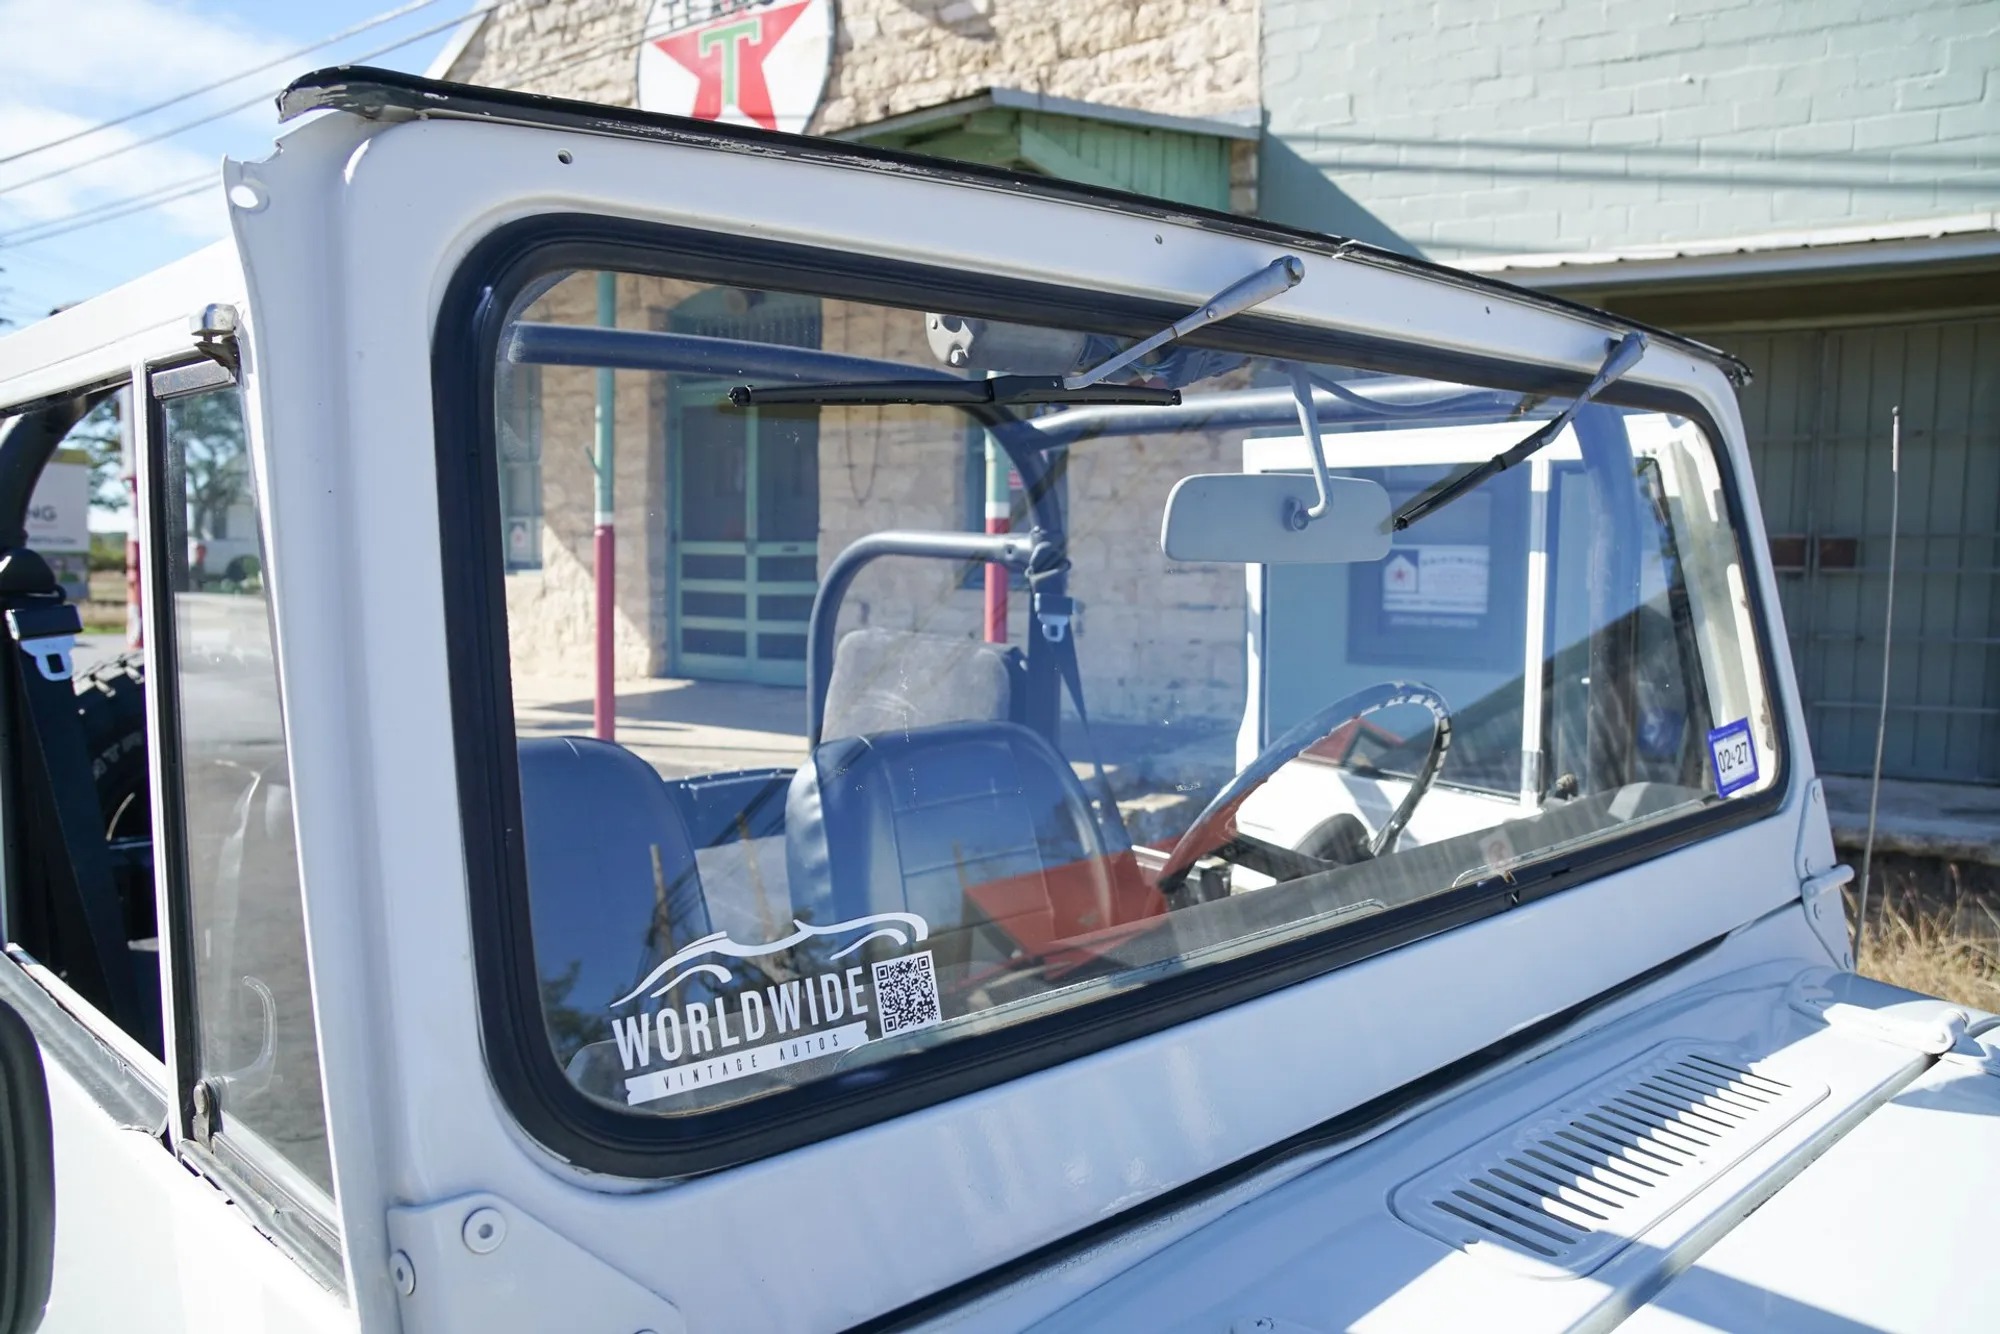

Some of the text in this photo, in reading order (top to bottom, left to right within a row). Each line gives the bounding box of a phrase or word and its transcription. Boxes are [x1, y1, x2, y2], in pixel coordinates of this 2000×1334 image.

[611, 966, 869, 1071] WORLDWIDE
[663, 1033, 839, 1090] VINTAGE AUTOS
